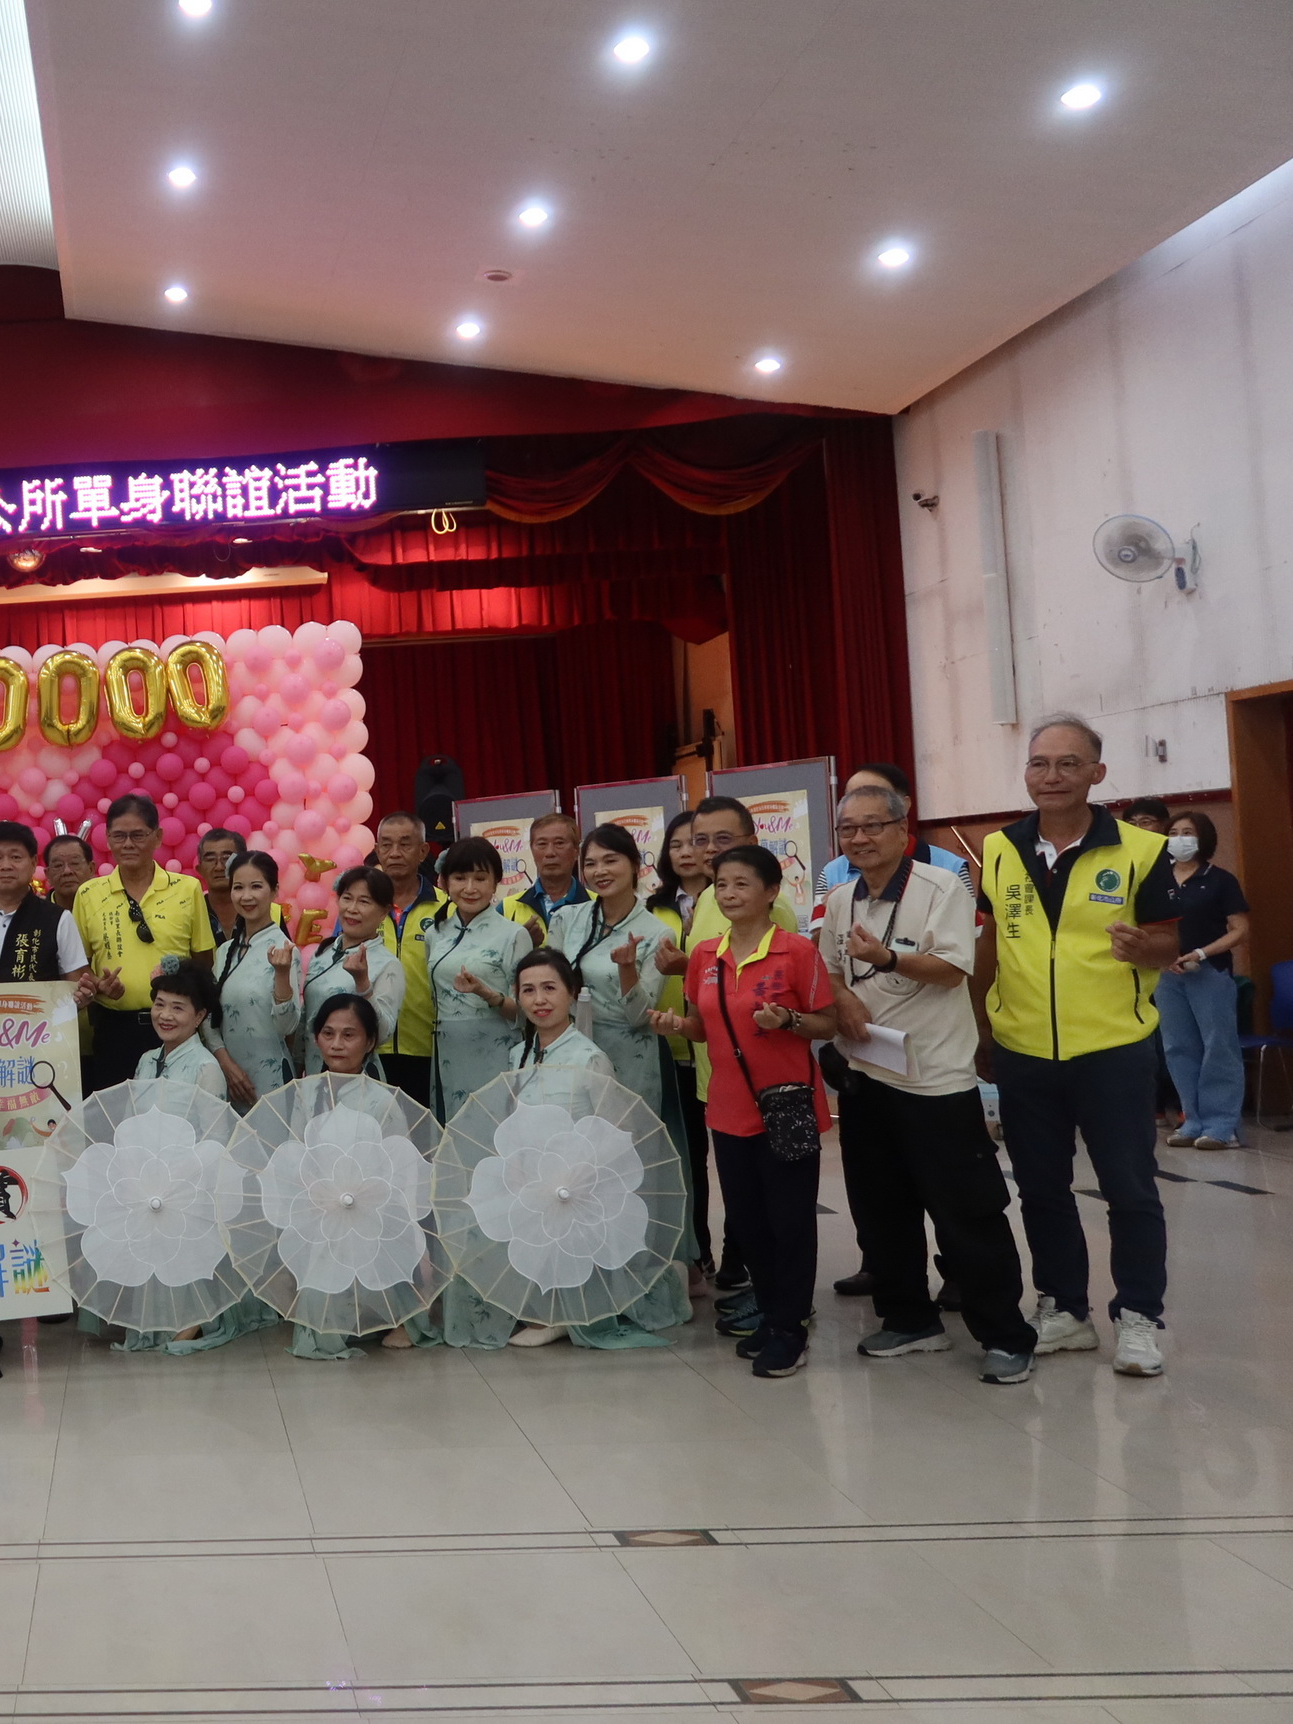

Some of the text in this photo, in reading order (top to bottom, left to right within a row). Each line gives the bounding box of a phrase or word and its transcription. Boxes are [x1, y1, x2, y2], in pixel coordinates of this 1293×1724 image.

[1004, 884, 1022, 939] 吳澤生
[11, 933, 30, 980] 張育彬
